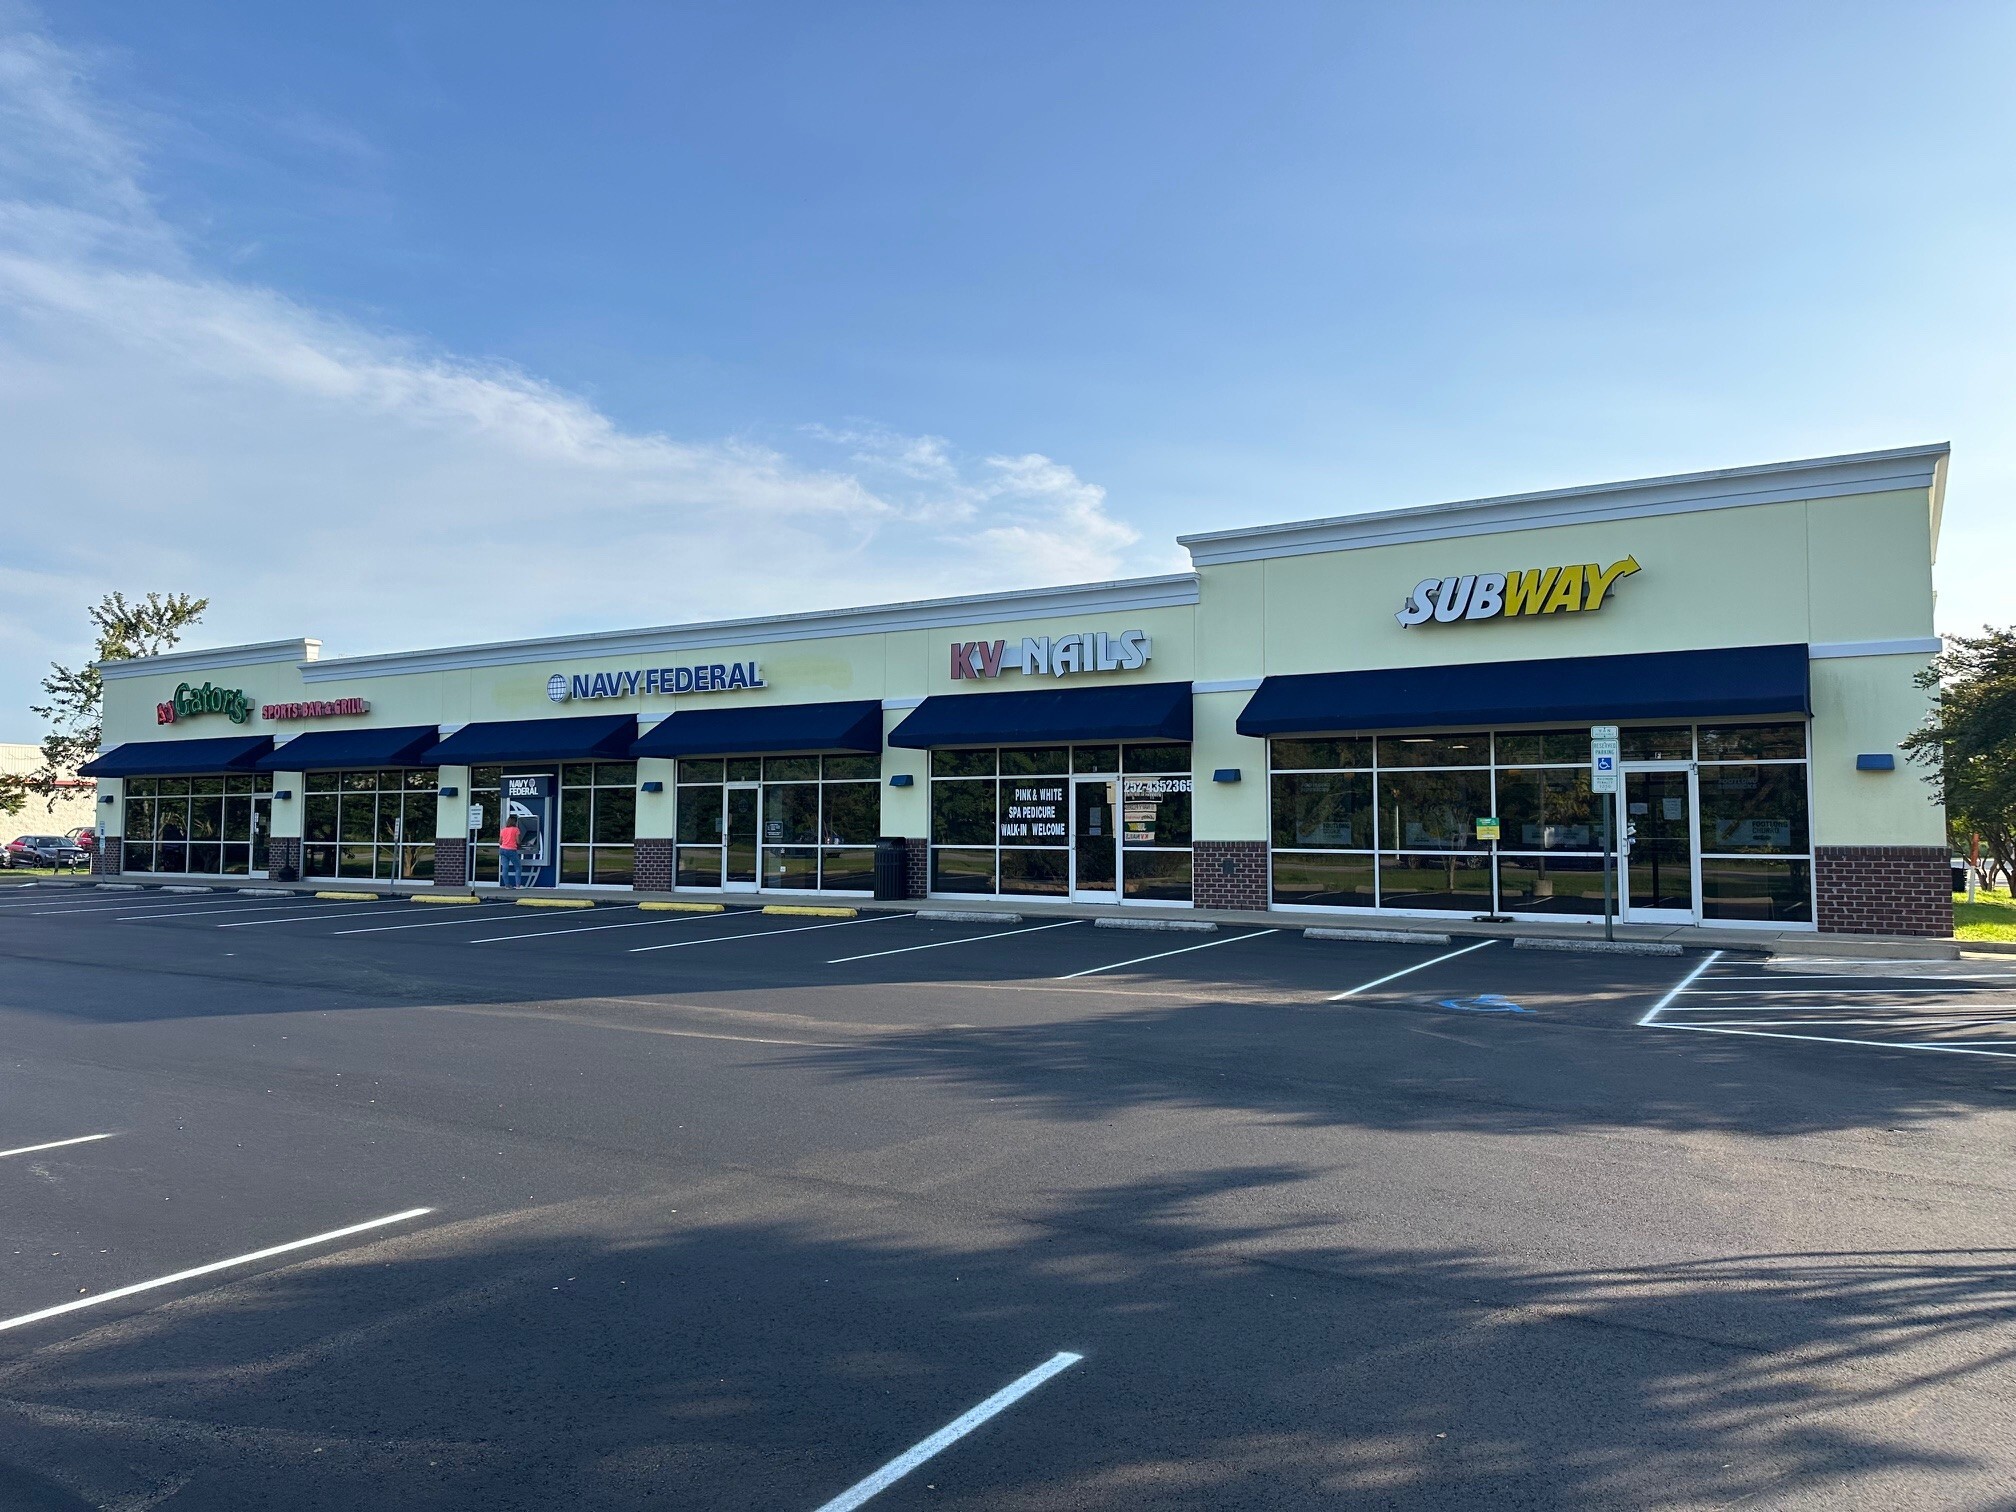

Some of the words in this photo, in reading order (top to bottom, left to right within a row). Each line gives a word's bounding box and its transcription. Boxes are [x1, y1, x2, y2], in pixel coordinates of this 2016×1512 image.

[1394, 554, 1641, 629] SUBWAY
[951, 640, 1005, 679] KV
[1021, 629, 1144, 678] NAILS
[571, 670, 642, 699] NAVY
[645, 661, 766, 694] FEDERAL
[262, 703, 299, 720] SPORTS
[301, 700, 323, 717] BAR
[324, 701, 332, 715] &
[334, 697, 365, 715] GRILL
[509, 779, 529, 788] NAVY
[1124, 780, 1193, 793] 252-4352365
[509, 787, 539, 796] FEDERAL
[1015, 788, 1032, 801] PINK
[1032, 788, 1038, 801] &
[1039, 788, 1063, 801] WHITE
[1008, 806, 1022, 819] SPA
[1022, 805, 1056, 819] PEDICURE
[1000, 823, 1027, 836] WALK-IN
[1031, 822, 1066, 836] WELCOME
[1752, 820, 1789, 828] FOOTLONG
